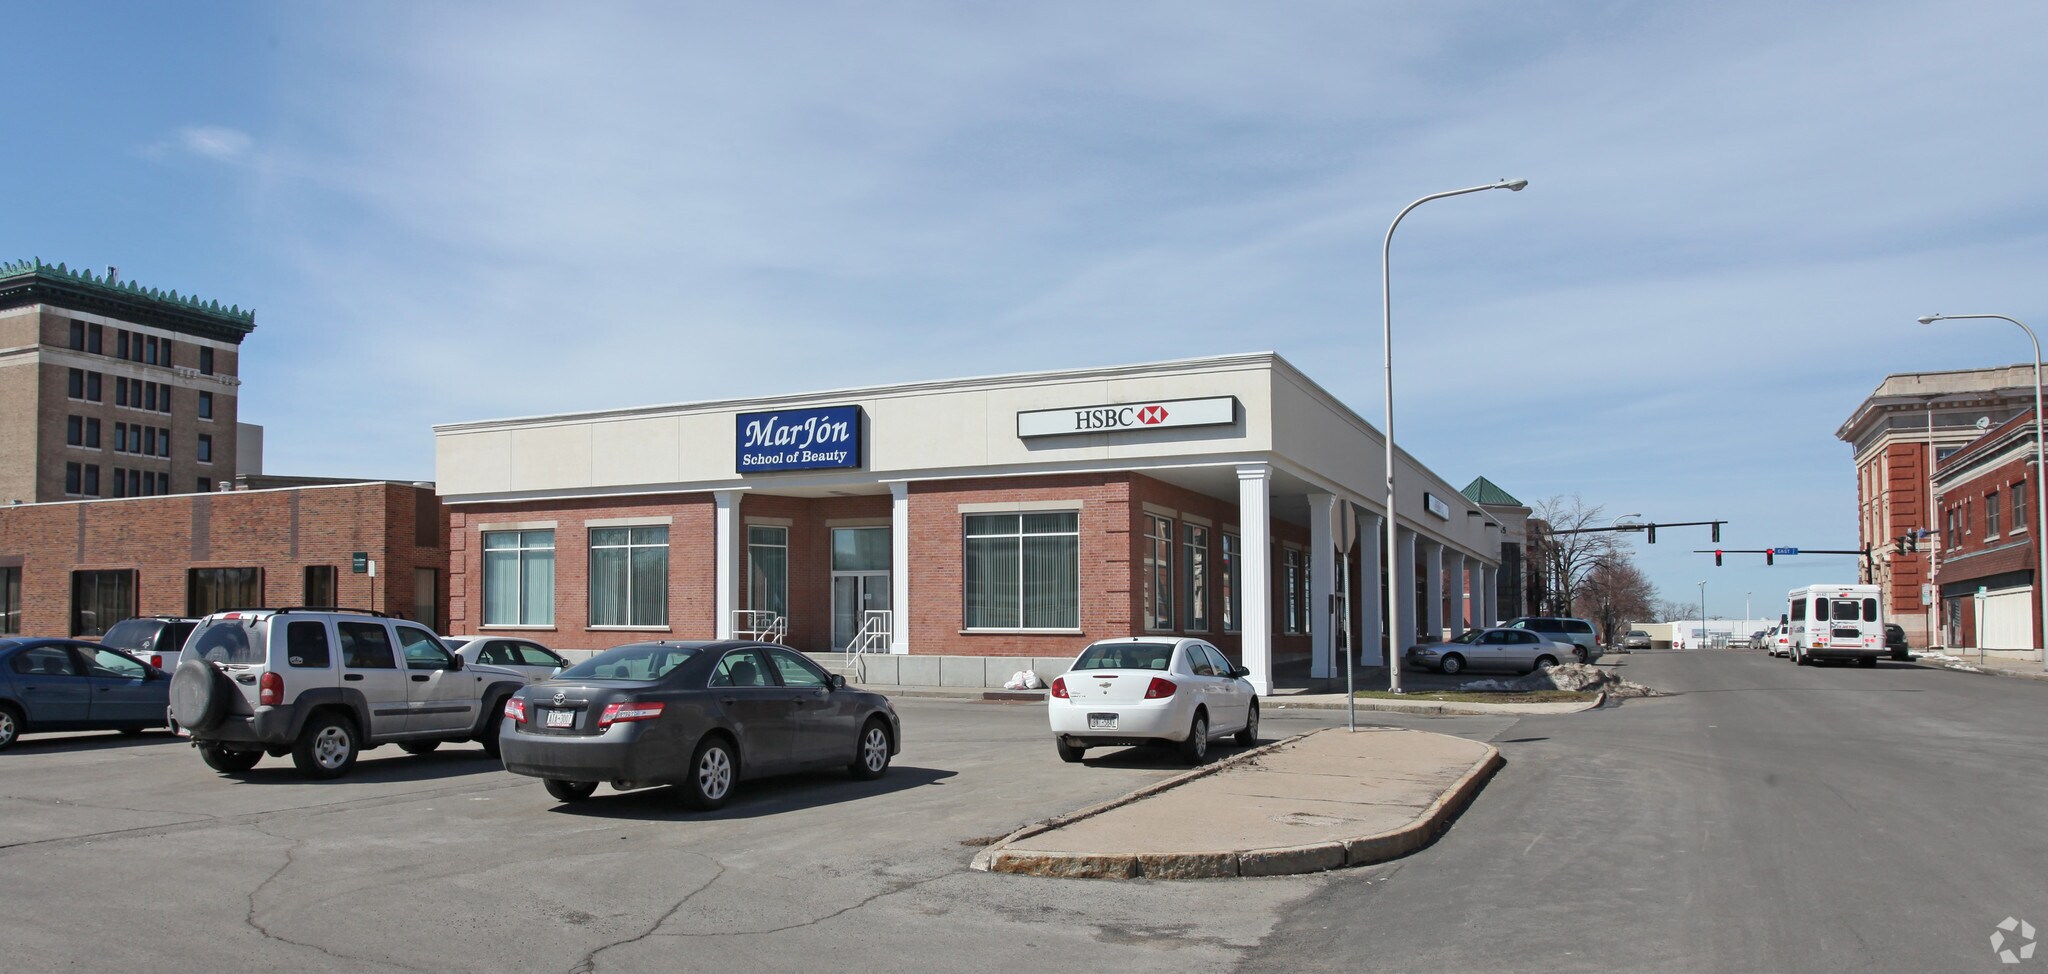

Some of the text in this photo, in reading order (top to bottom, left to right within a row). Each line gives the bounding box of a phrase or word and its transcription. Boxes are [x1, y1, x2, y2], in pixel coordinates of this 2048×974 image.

[1075, 407, 1134, 429] HSBC
[744, 416, 849, 449] MarJón
[743, 449, 848, 465] School of Beauty
